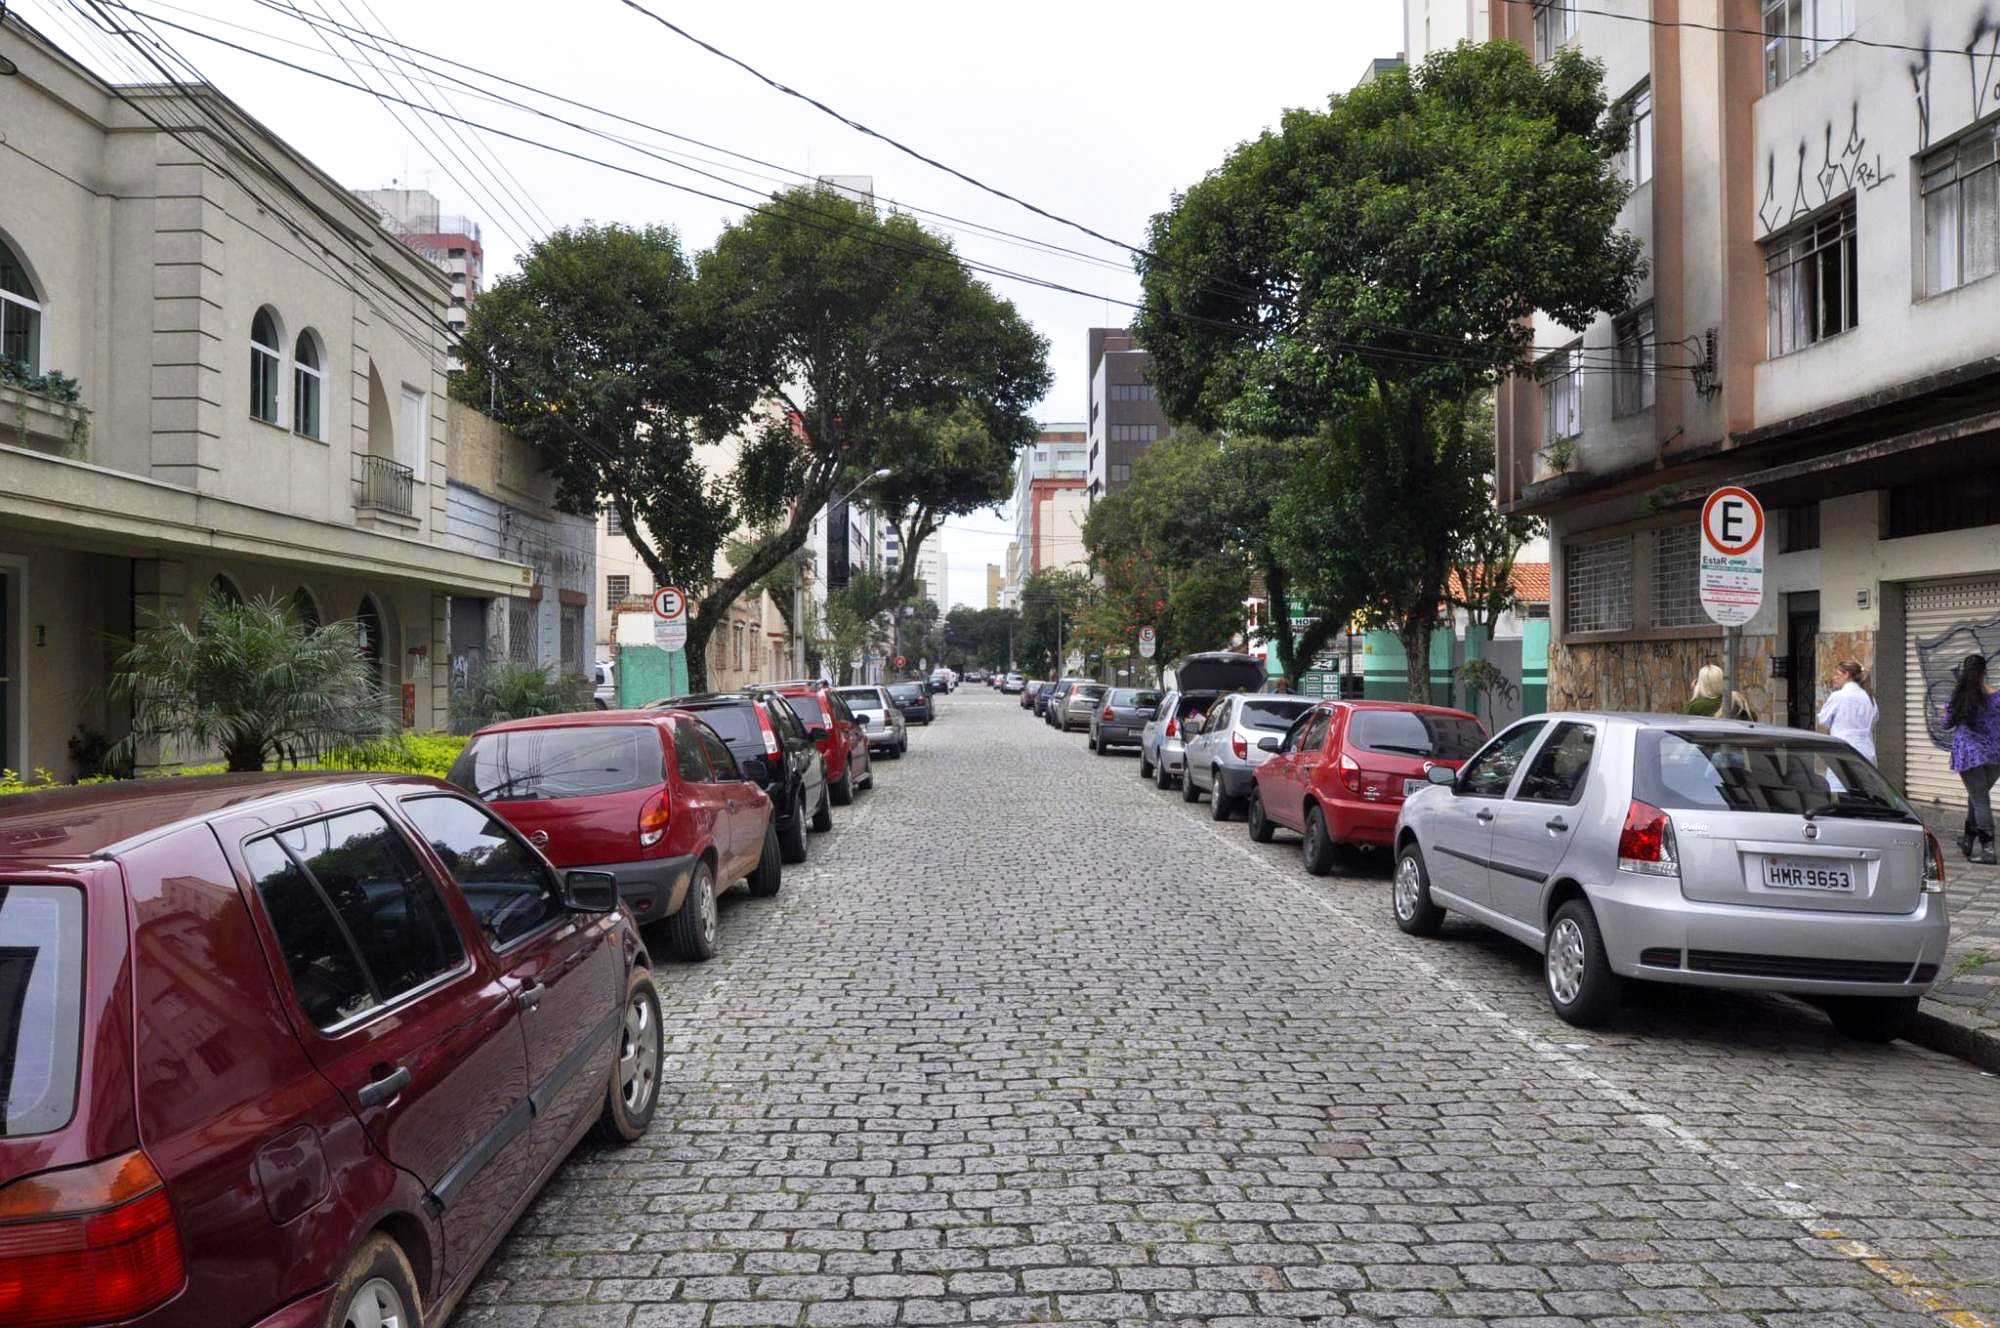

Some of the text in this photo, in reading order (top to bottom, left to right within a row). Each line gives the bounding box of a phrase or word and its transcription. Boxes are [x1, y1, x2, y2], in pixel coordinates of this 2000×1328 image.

[1721, 500, 1743, 542] E
[1702, 556, 1729, 566] EstaR
[663, 593, 675, 613] E
[1144, 629, 1152, 638] E
